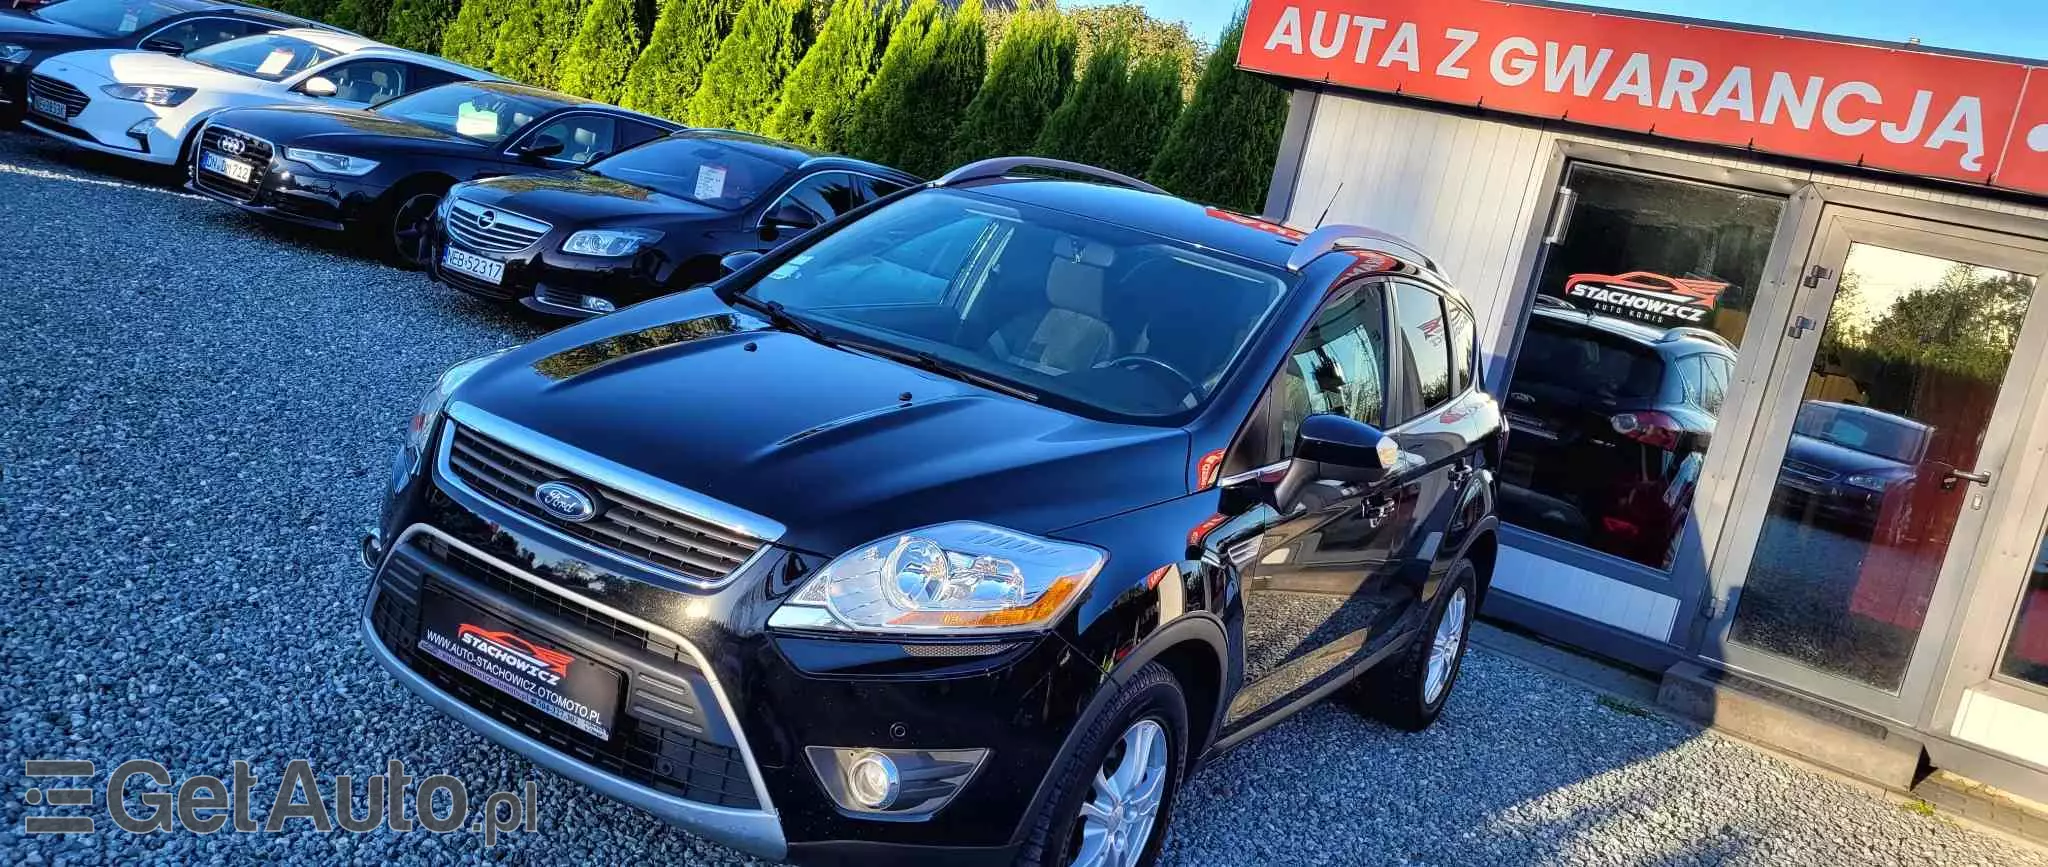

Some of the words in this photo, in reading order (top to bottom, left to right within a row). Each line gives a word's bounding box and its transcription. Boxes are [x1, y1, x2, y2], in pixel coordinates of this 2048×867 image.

[1264, 6, 1422, 71] AUTA
[1435, 27, 1482, 79] Z
[1489, 36, 1985, 172] GWARANCJĄ
[466, 256, 502, 278] 52317
[1571, 283, 1707, 322] STACHOWICZ
[1594, 303, 1622, 314] AUTO
[1629, 310, 1664, 324] KOMIS
[544, 490, 577, 513] Ford
[460, 632, 561, 686] STACHOWICZ
